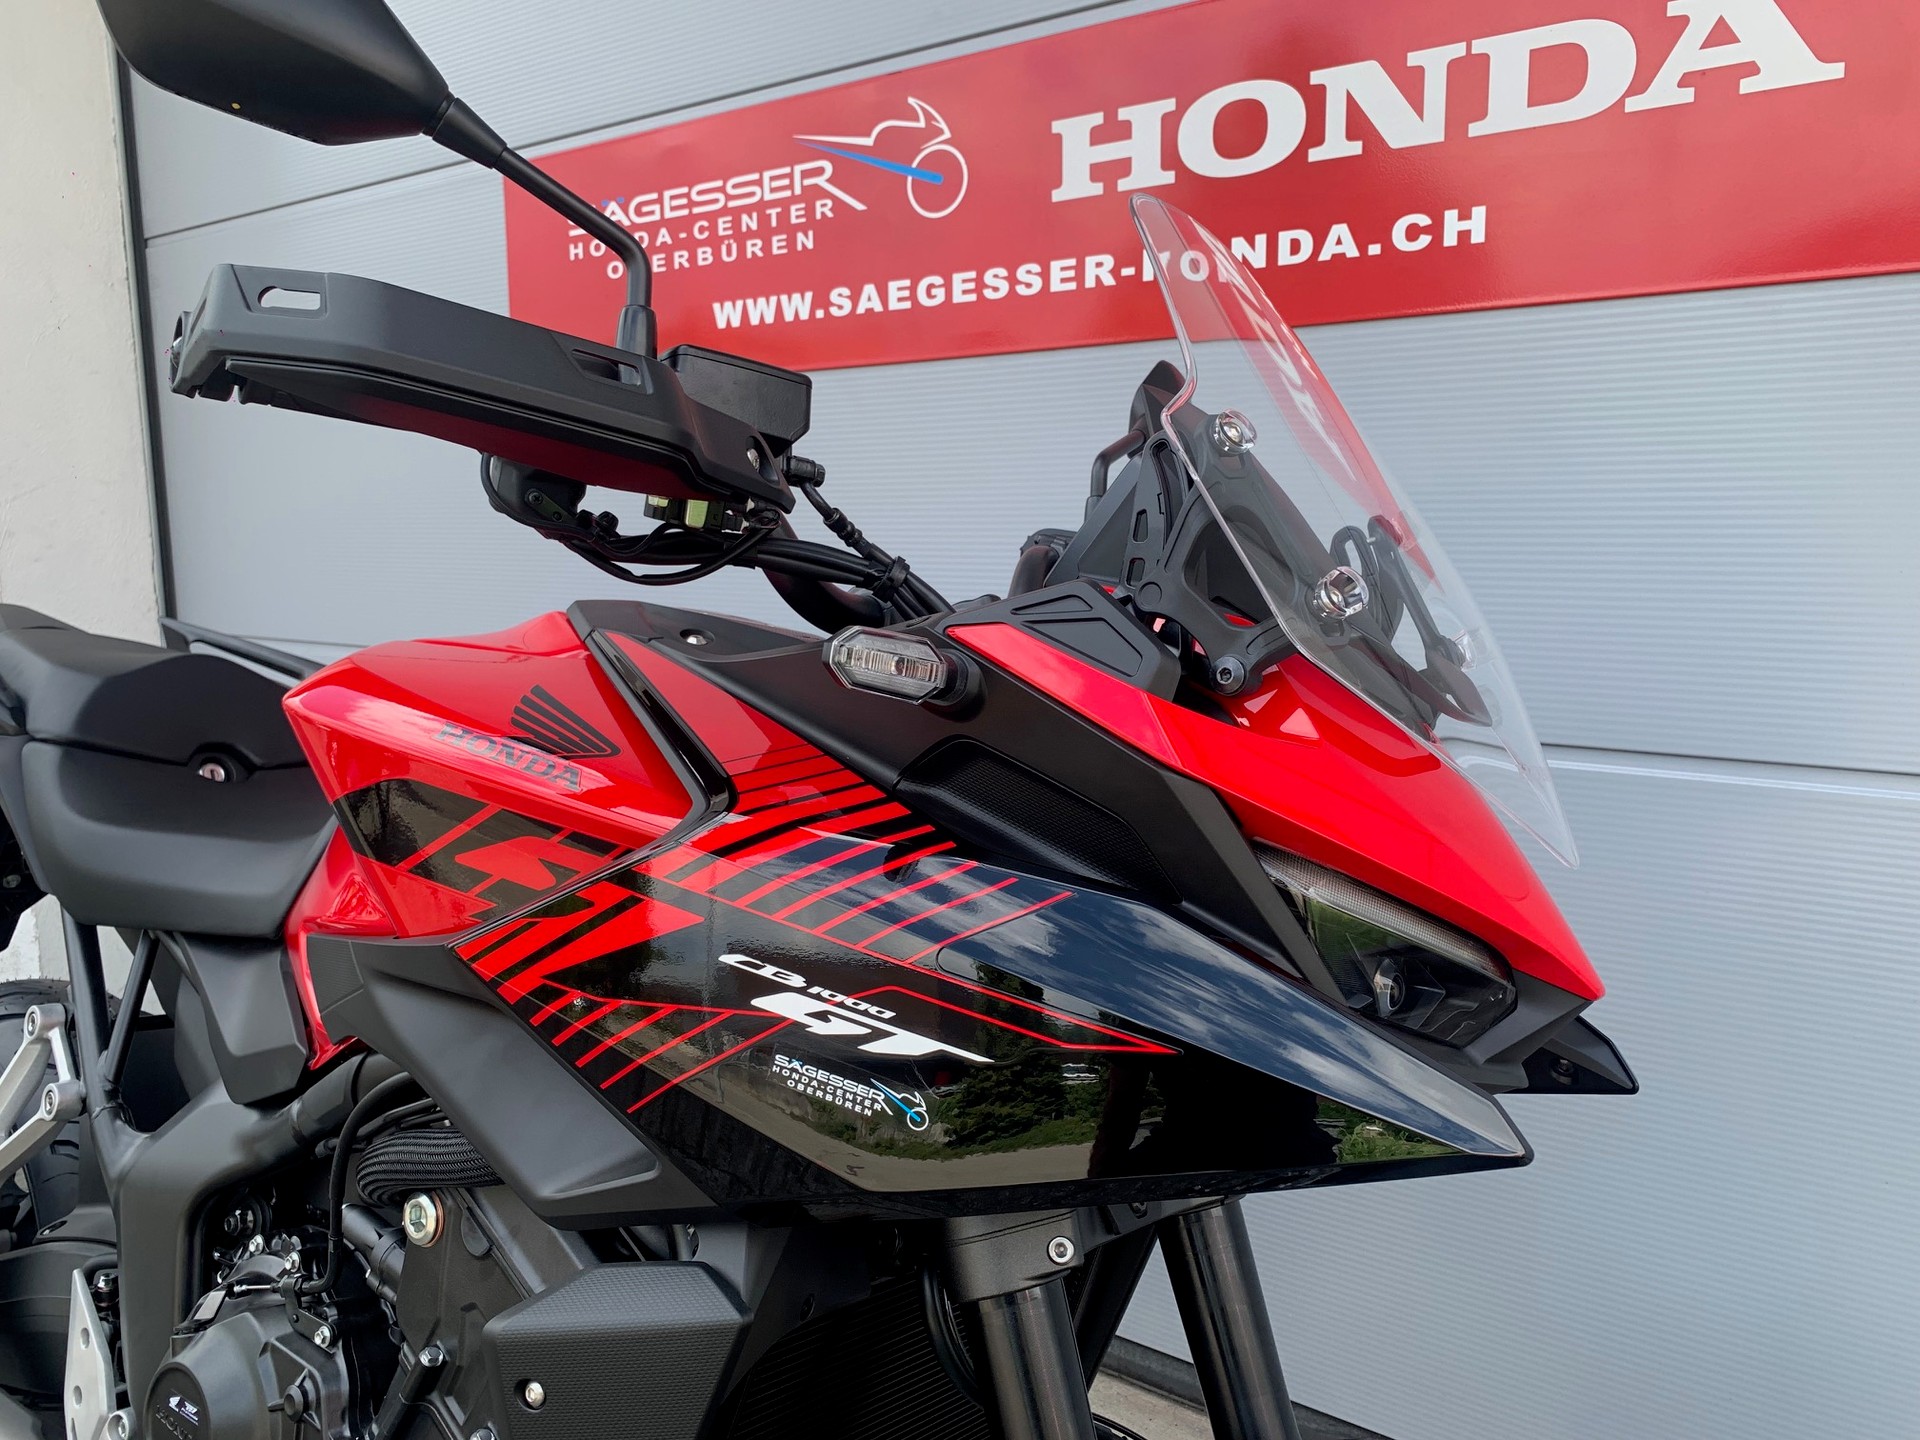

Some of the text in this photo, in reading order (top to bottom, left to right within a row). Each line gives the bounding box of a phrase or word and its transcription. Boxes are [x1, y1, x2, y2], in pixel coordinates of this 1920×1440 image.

[1051, 0, 1846, 202] HONDA
[567, 159, 868, 237] ÄGESSER
[569, 199, 834, 261] HODA-CENTER
[606, 230, 814, 279] OERBÜREN
[435, 721, 581, 792] HONDA
[772, 1065, 882, 1112] HONDA-CENTER
[773, 1053, 894, 1116] SÄGESSER
[786, 1079, 873, 1117] OBERBÜREN
